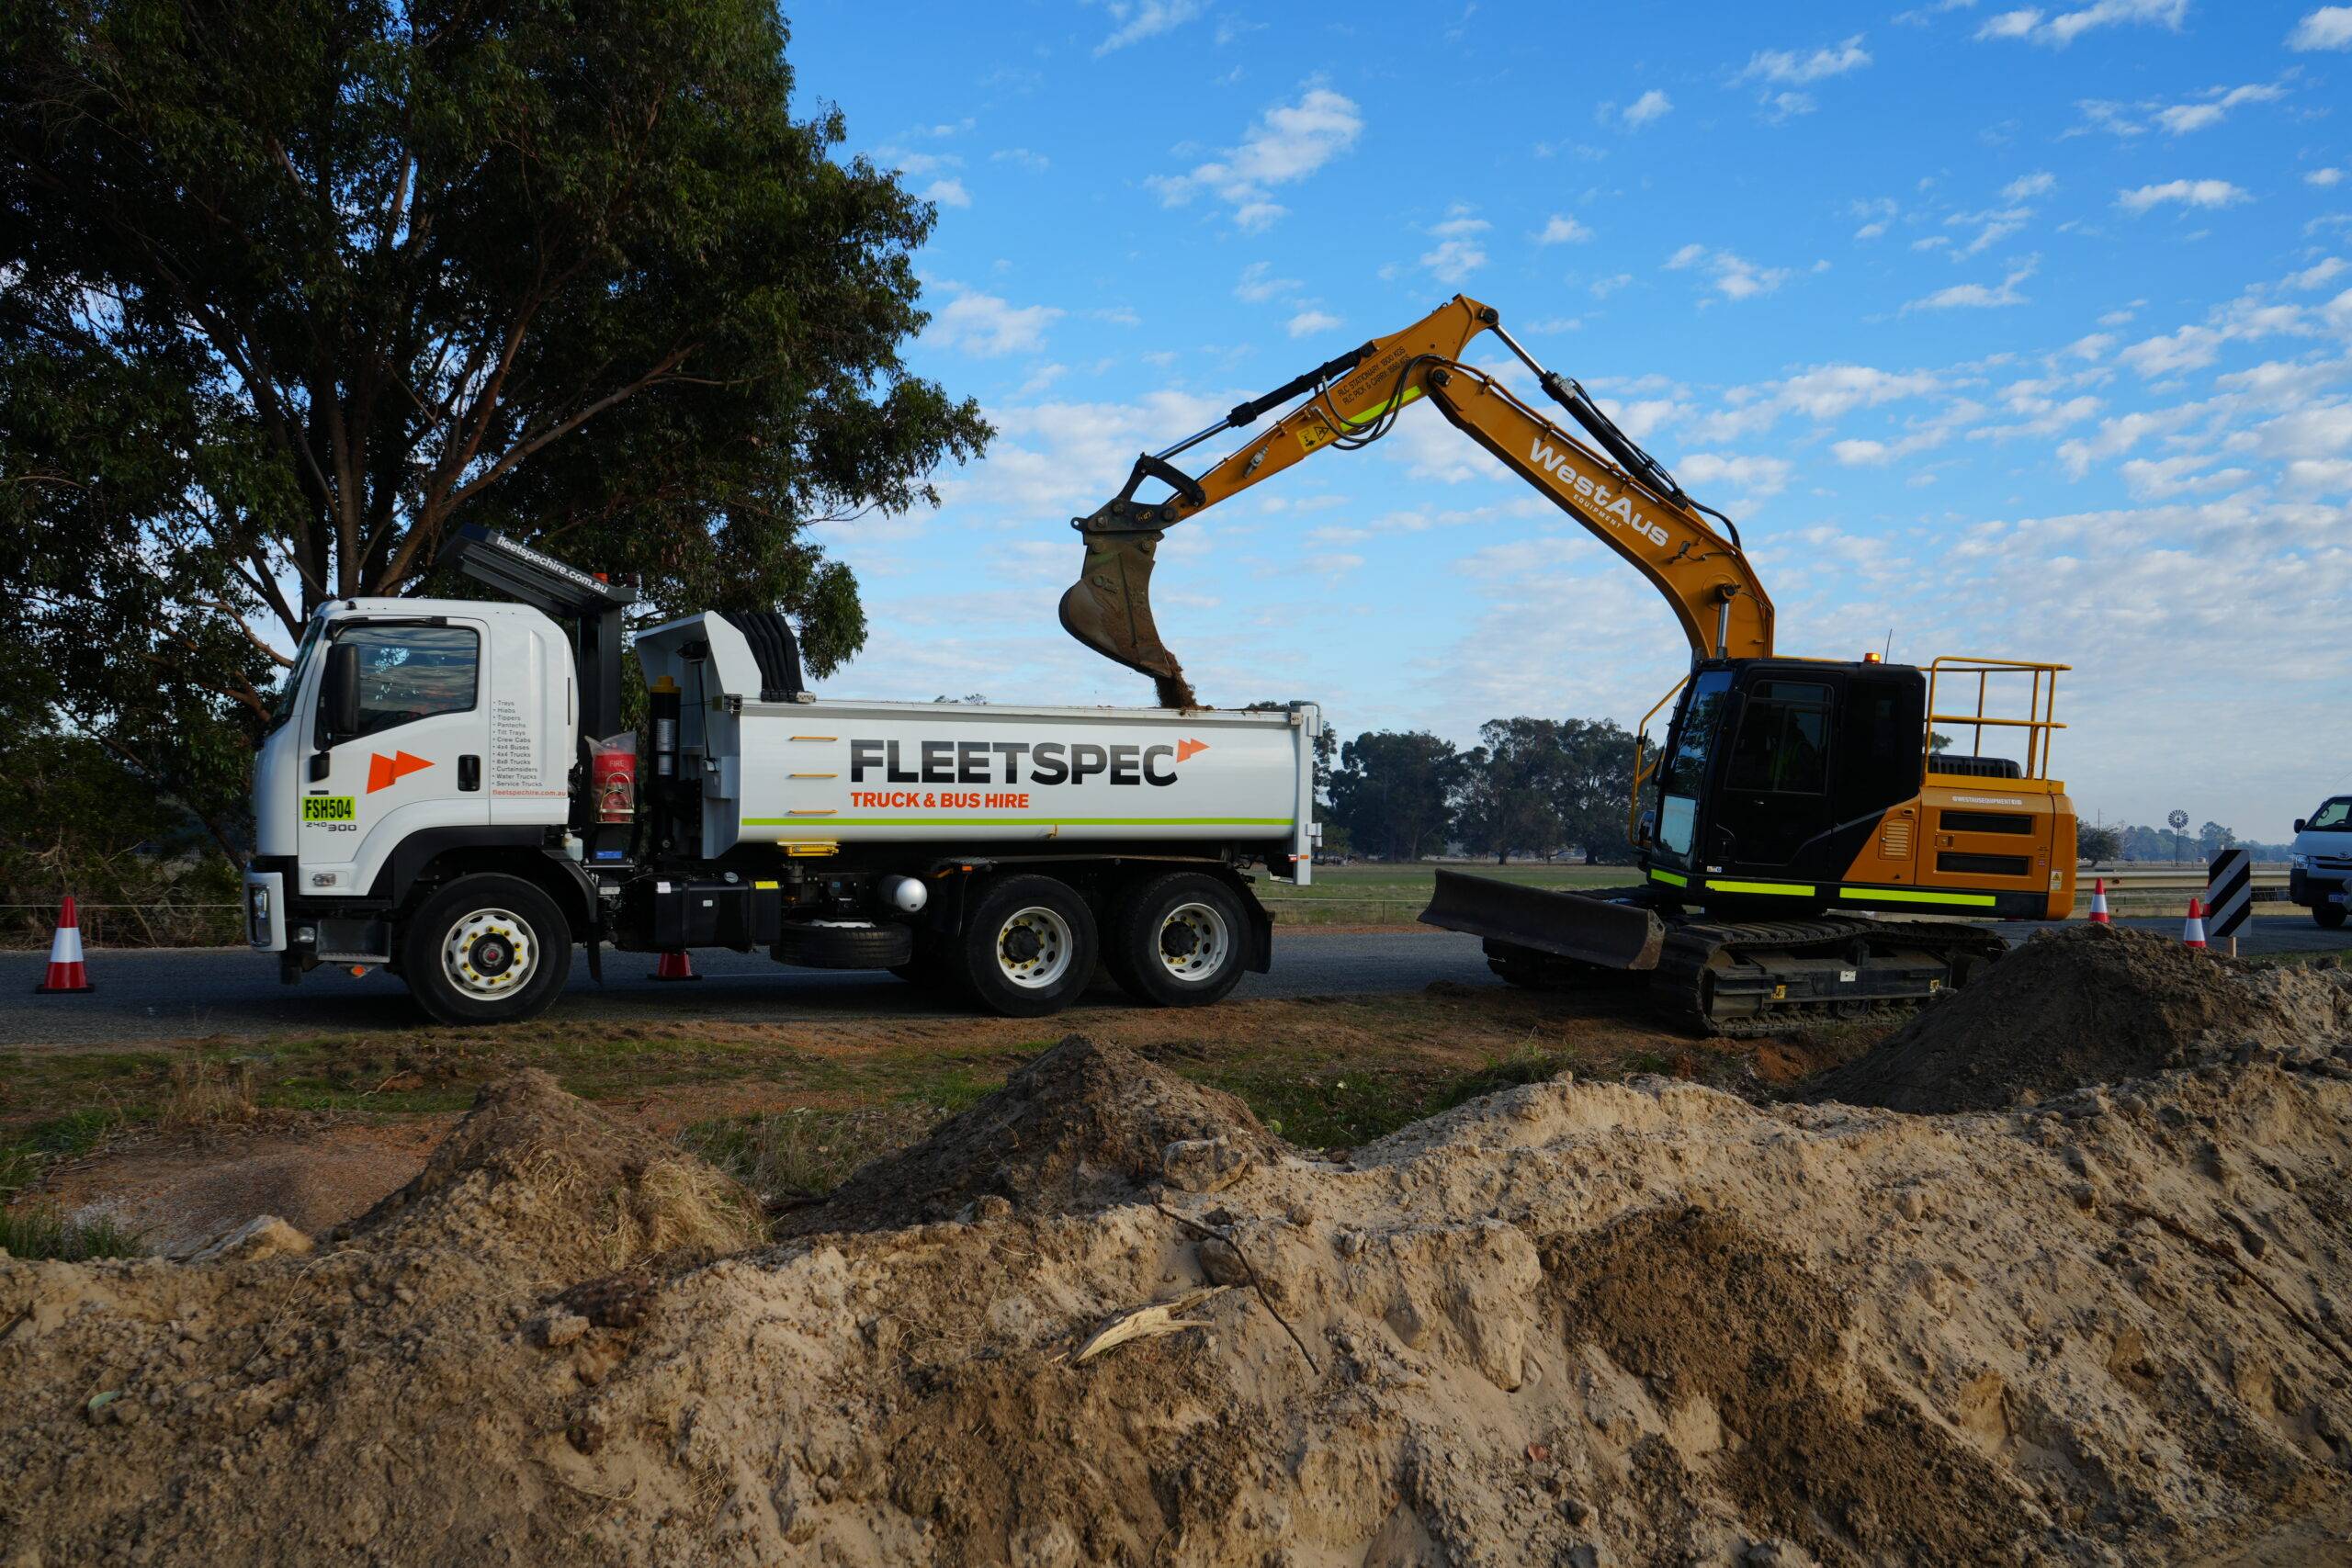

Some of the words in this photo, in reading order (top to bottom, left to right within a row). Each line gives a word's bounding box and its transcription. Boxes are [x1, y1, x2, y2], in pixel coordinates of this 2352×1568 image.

[1394, 345, 1406, 358] KGS
[1530, 437, 1669, 547] WestAus
[1572, 493, 1622, 528] EQUIPMENT
[496, 536, 608, 594] fleetspechire.com.au
[851, 739, 1178, 786] FLEETSPEC
[305, 799, 352, 818] FSH504
[851, 792, 919, 807] TRUCK
[922, 793, 935, 808] &
[941, 793, 980, 808] BUS
[985, 794, 1029, 808] HIRE
